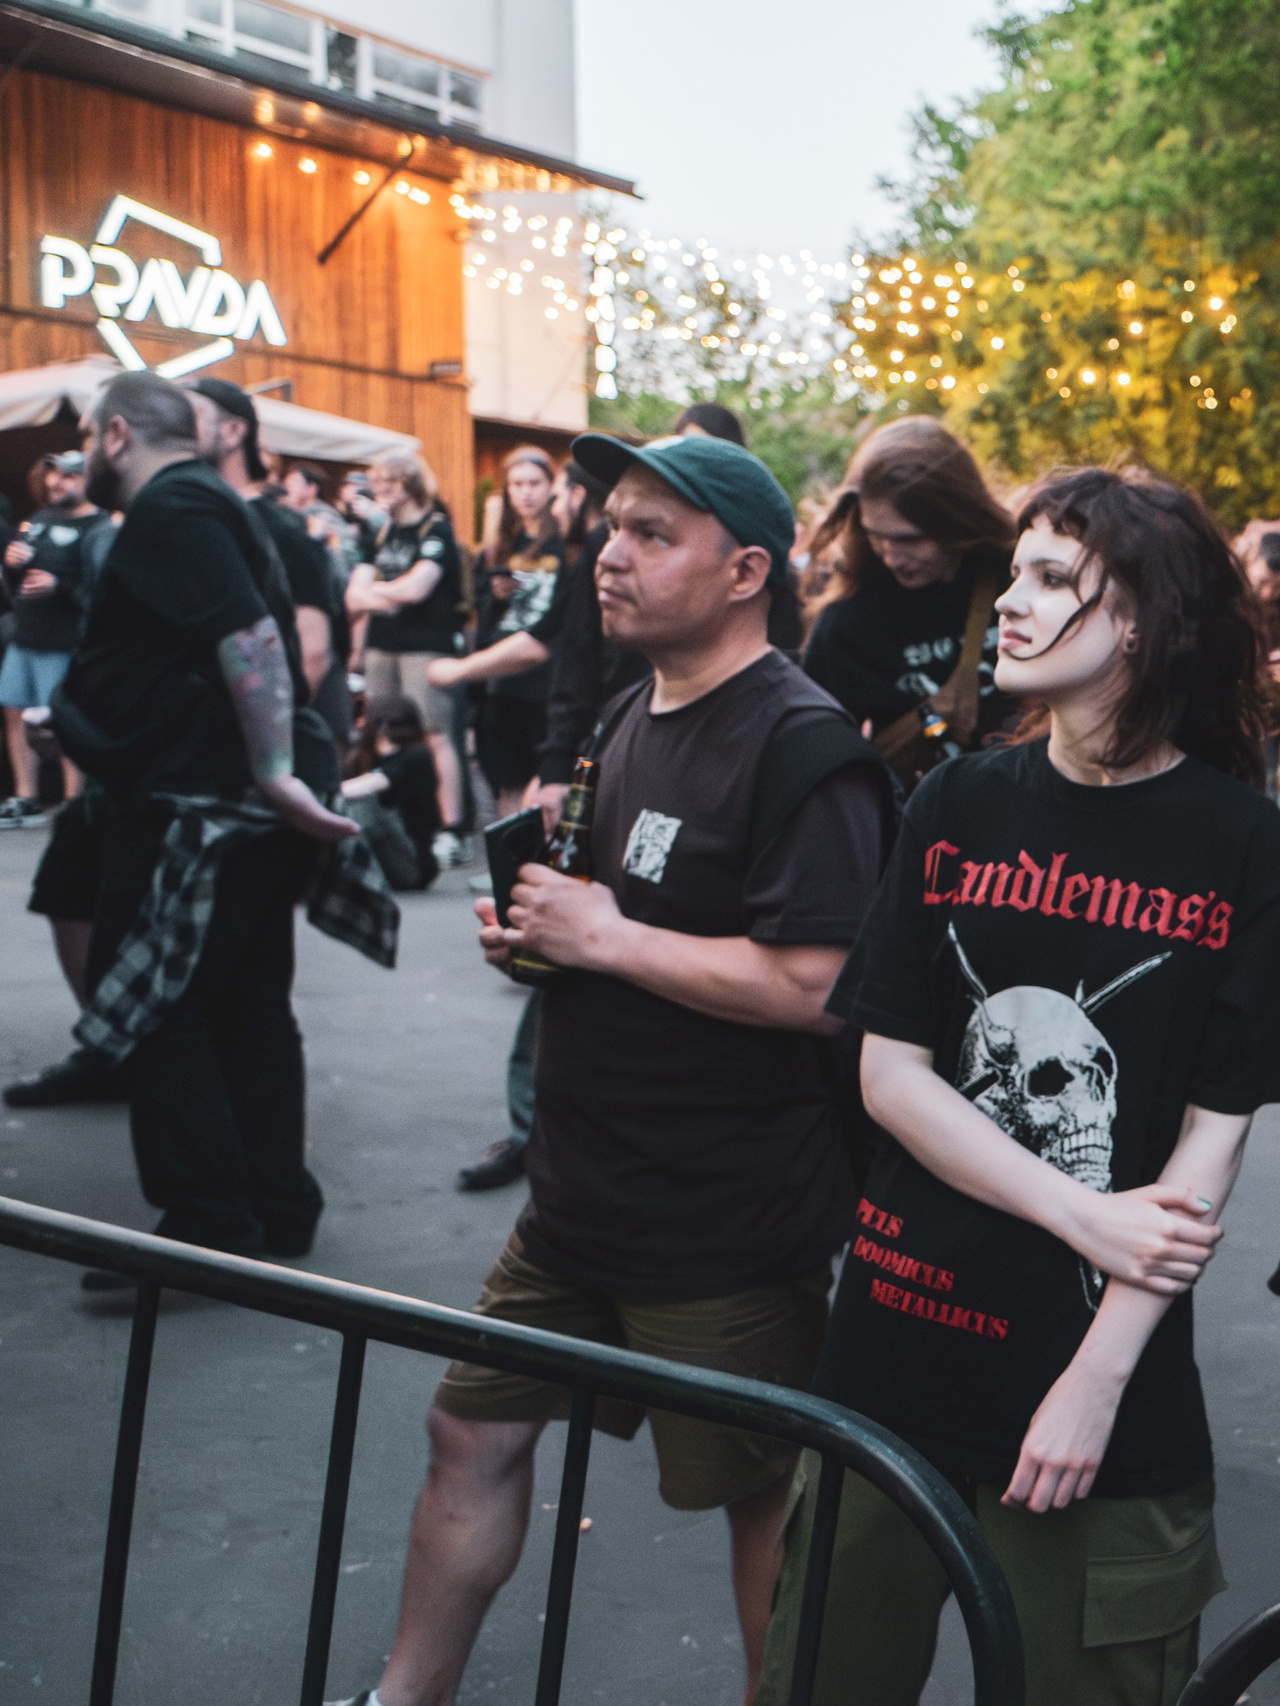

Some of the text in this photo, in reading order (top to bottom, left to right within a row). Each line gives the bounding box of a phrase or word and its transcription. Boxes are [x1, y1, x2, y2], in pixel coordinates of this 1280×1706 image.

[42, 235, 287, 346] PRAVDA
[923, 840, 1234, 950] Candlemass
[869, 1278, 1009, 1340] METALLICUS
